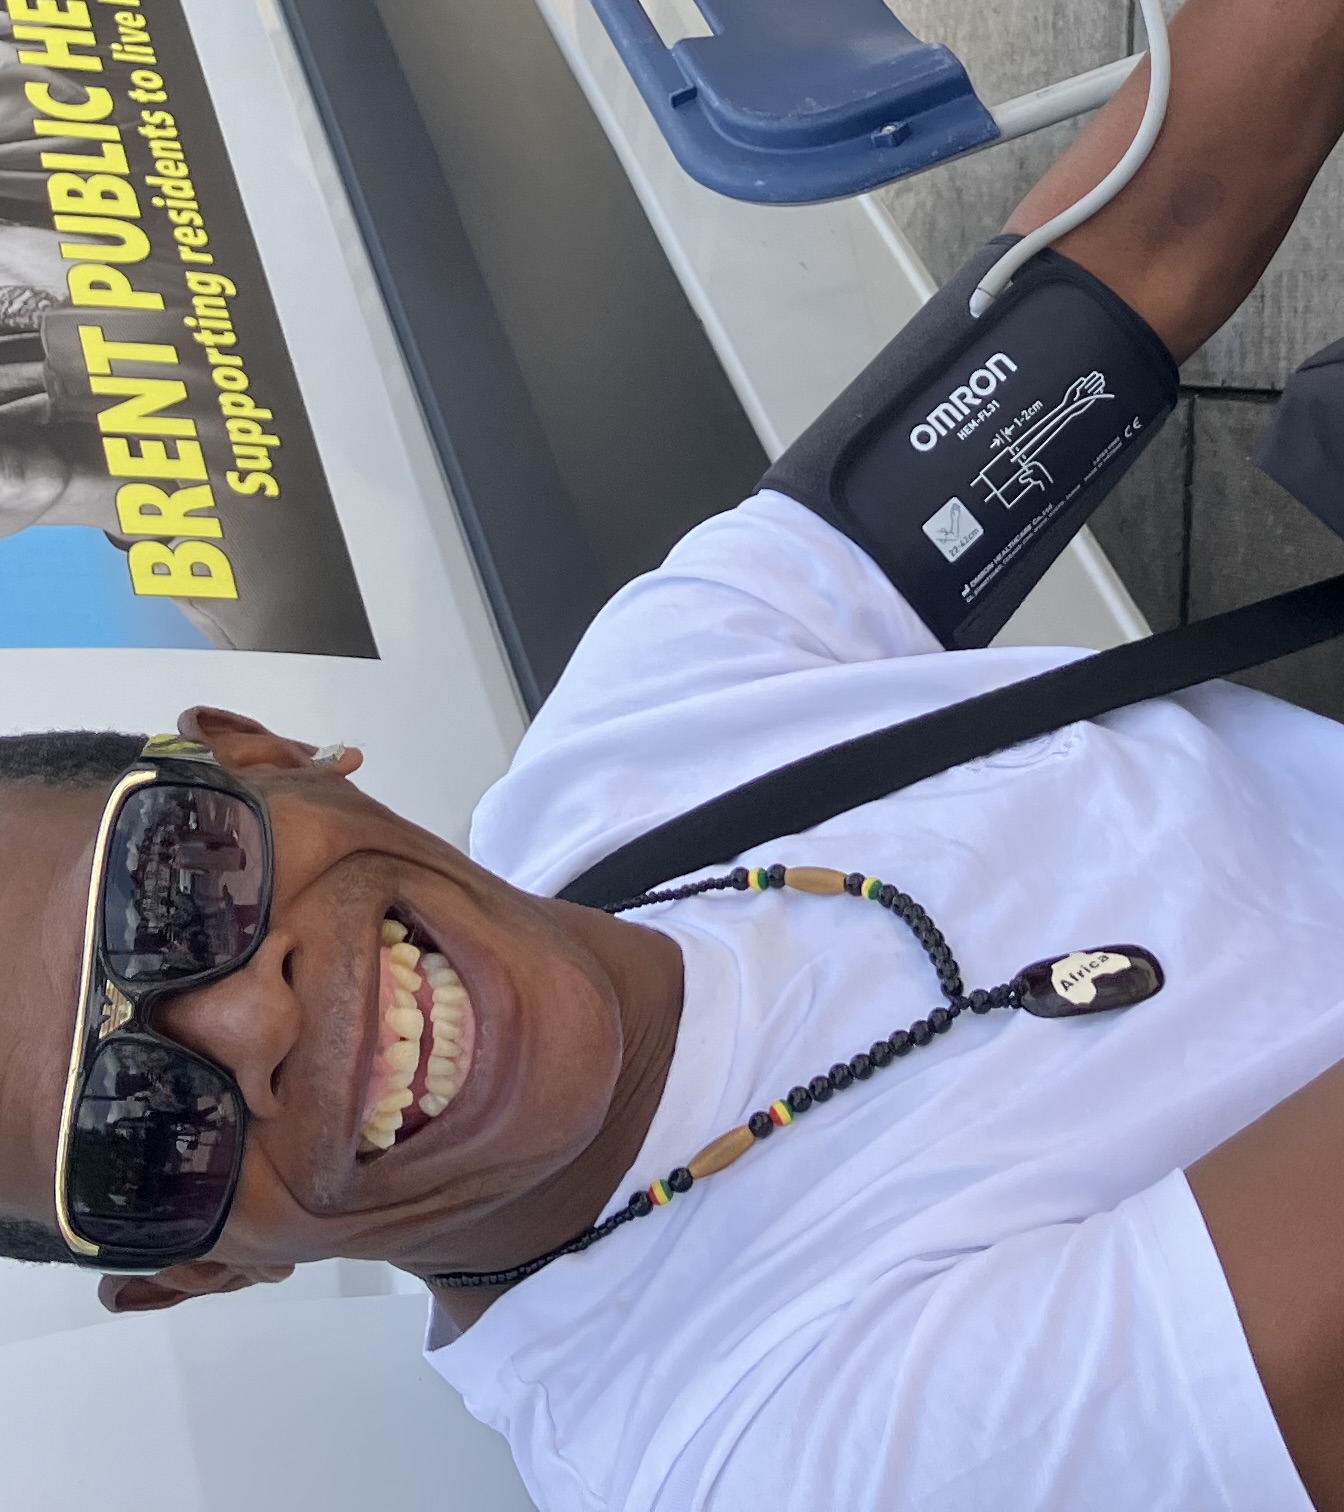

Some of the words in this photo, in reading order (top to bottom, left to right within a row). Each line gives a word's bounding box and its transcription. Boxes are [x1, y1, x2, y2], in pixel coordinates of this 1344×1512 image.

[105, 12, 159, 64] live
[132, 69, 170, 103] to
[23, 81, 166, 311] PUBLIC
[138, 110, 214, 263] residents
[182, 272, 281, 498] Supporting
[956, 398, 1002, 441] HEM-FL31
[1012, 399, 1044, 427] 1-2cm
[78, 325, 241, 600] BRENT
[1060, 953, 1110, 992] Africa
